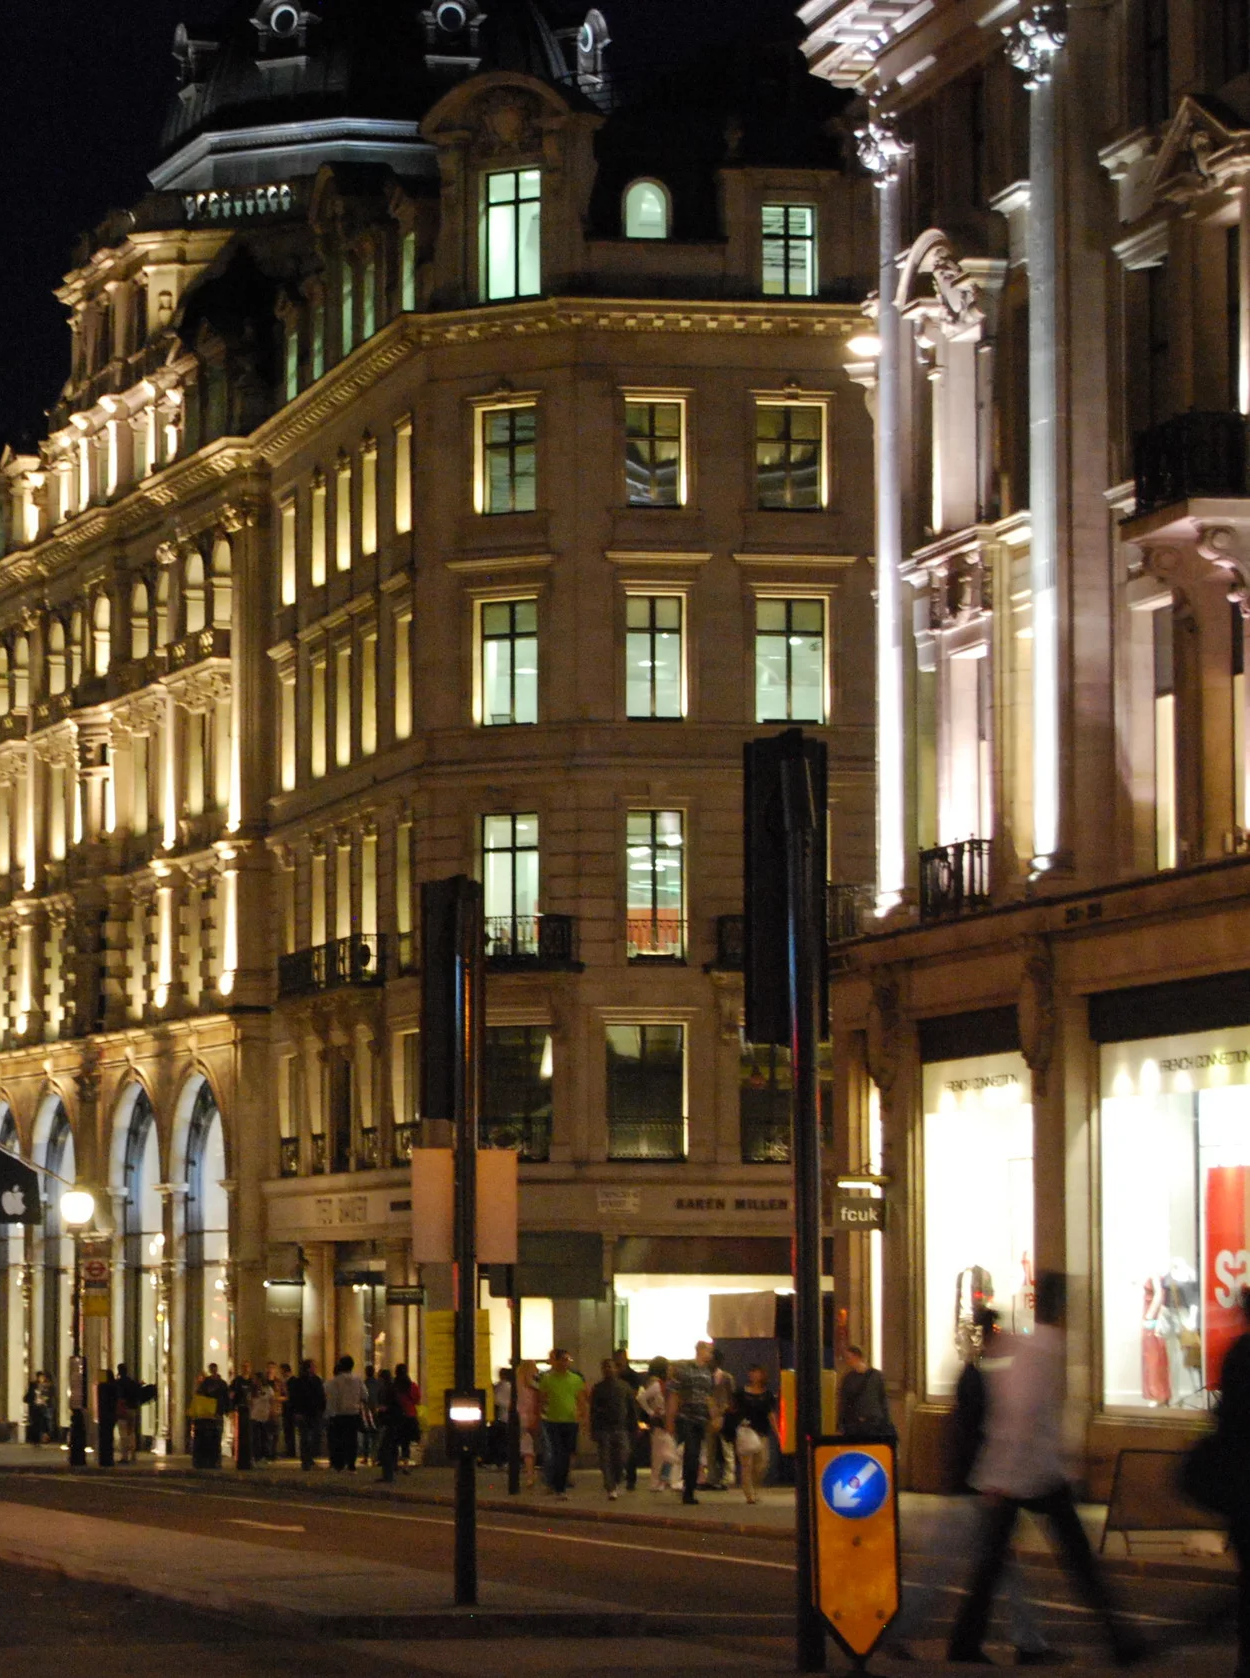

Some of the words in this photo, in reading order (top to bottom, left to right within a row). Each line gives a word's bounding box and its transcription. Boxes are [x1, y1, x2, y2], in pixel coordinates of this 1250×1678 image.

[1161, 1056, 1194, 1073] FRENCH
[676, 1199, 725, 1210] KAREN
[735, 1198, 788, 1210] MILLEN
[841, 1206, 878, 1221] fcuk
